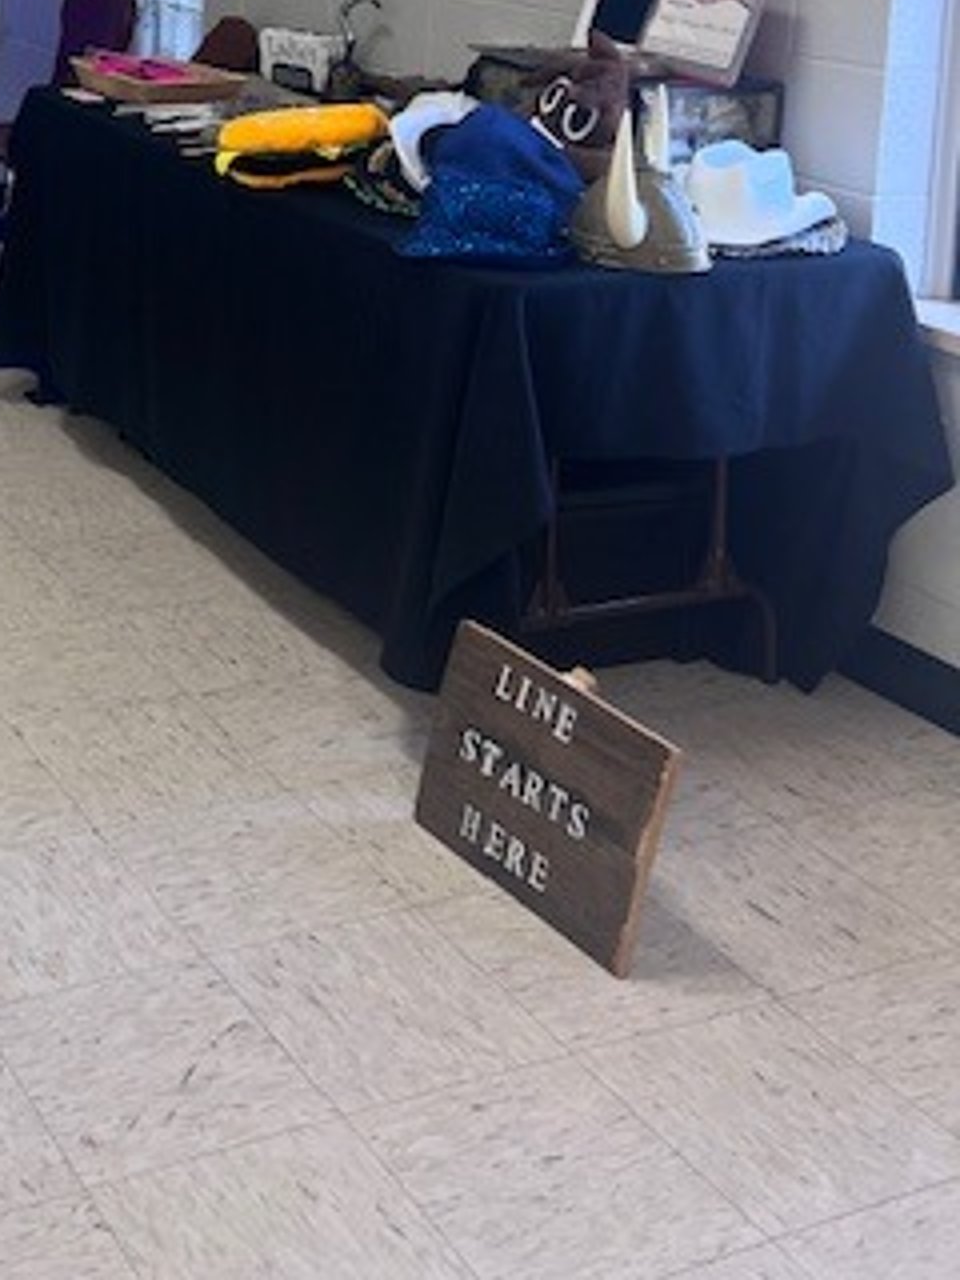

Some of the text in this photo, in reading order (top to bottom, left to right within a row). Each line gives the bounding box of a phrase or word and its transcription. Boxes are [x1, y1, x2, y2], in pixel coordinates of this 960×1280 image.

[495, 665, 577, 744] LINE
[459, 728, 590, 841] STARTS
[459, 804, 550, 893] HERE
